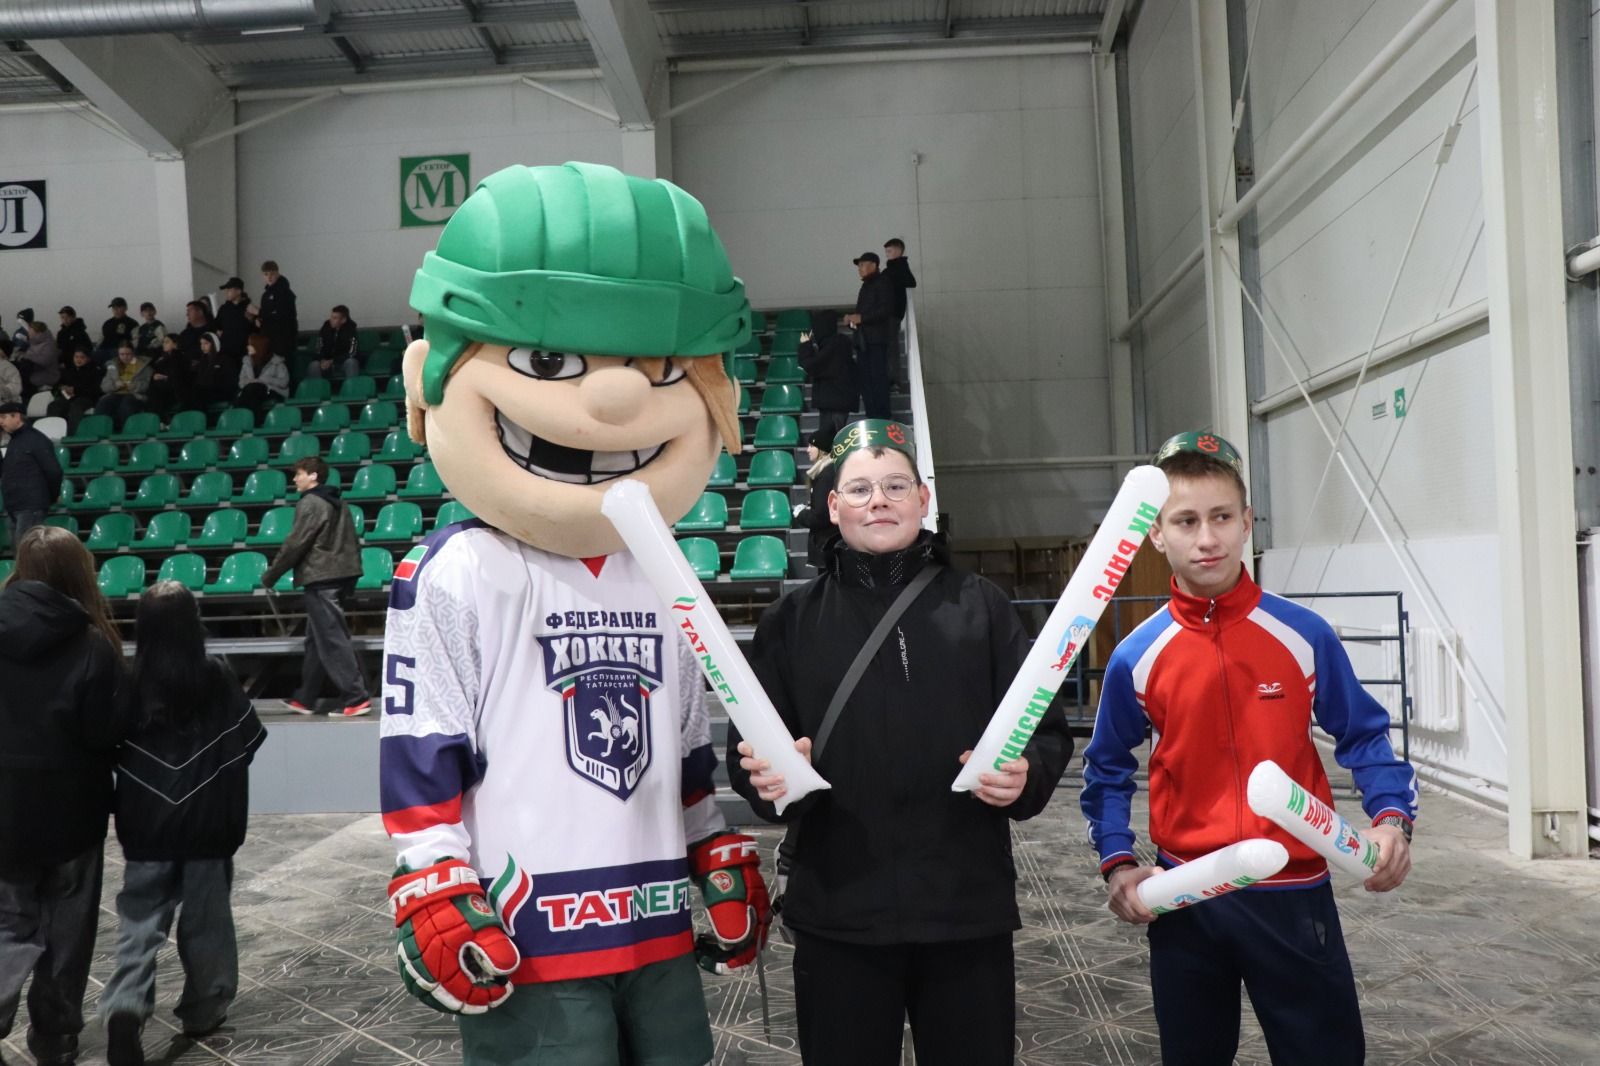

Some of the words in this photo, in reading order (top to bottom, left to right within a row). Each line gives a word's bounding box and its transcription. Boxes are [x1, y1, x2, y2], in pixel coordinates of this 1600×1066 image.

[413, 170, 458, 209] М
[545, 610, 657, 630] ФЕДЕРАЦИЯ
[550, 635, 657, 675] ХОККЕЯ
[679, 616, 740, 706] TATNEFT
[385, 653, 416, 716] 5
[579, 673, 638, 682] РЕСПУБЛИКИ
[585, 681, 635, 689] ТАТАРСТАН
[389, 866, 481, 916] TRUE
[536, 877, 690, 932] TATNEF
